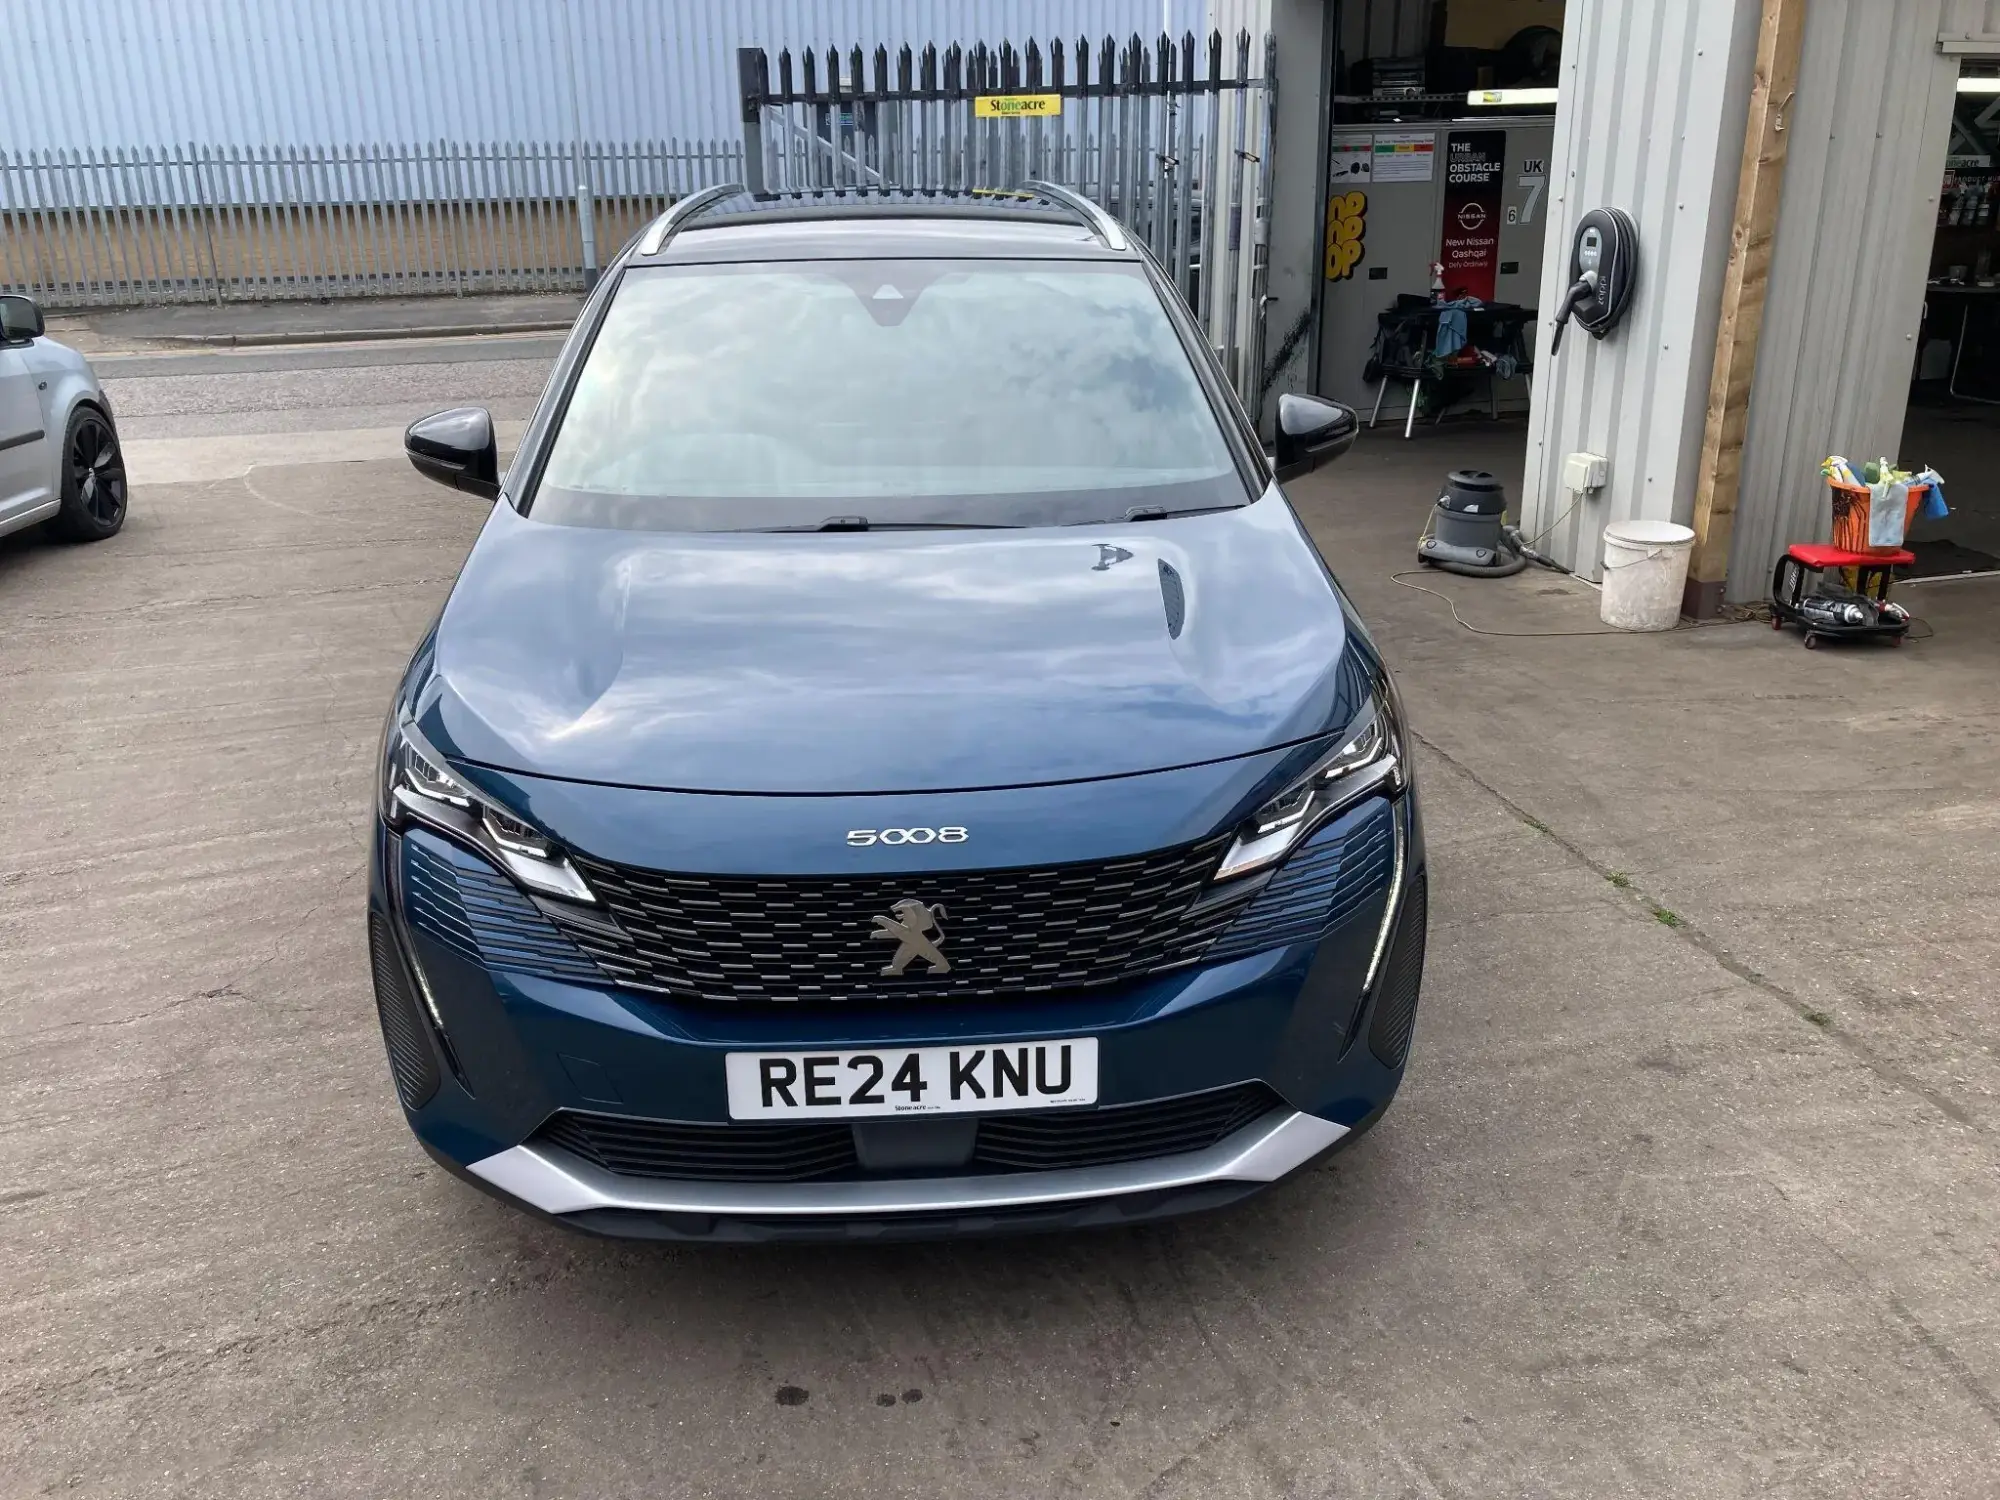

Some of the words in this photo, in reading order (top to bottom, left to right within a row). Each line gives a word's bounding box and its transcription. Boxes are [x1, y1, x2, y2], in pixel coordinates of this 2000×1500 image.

[990, 99, 1046, 112] Stoneacre
[1450, 142, 1471, 152] THE
[1449, 162, 1501, 173] OBSTACLE
[1524, 160, 1543, 173] UK
[1448, 173, 1490, 183] COURSE
[1518, 174, 1547, 225] 7
[1508, 209, 1517, 223] 6
[1445, 239, 1465, 247] New
[1466, 237, 1494, 246] Nissan
[1451, 249, 1487, 259] Qashqai
[846, 826, 970, 847] 5008
[759, 1052, 928, 1108] RE24
[949, 1044, 1072, 1101] KNU
